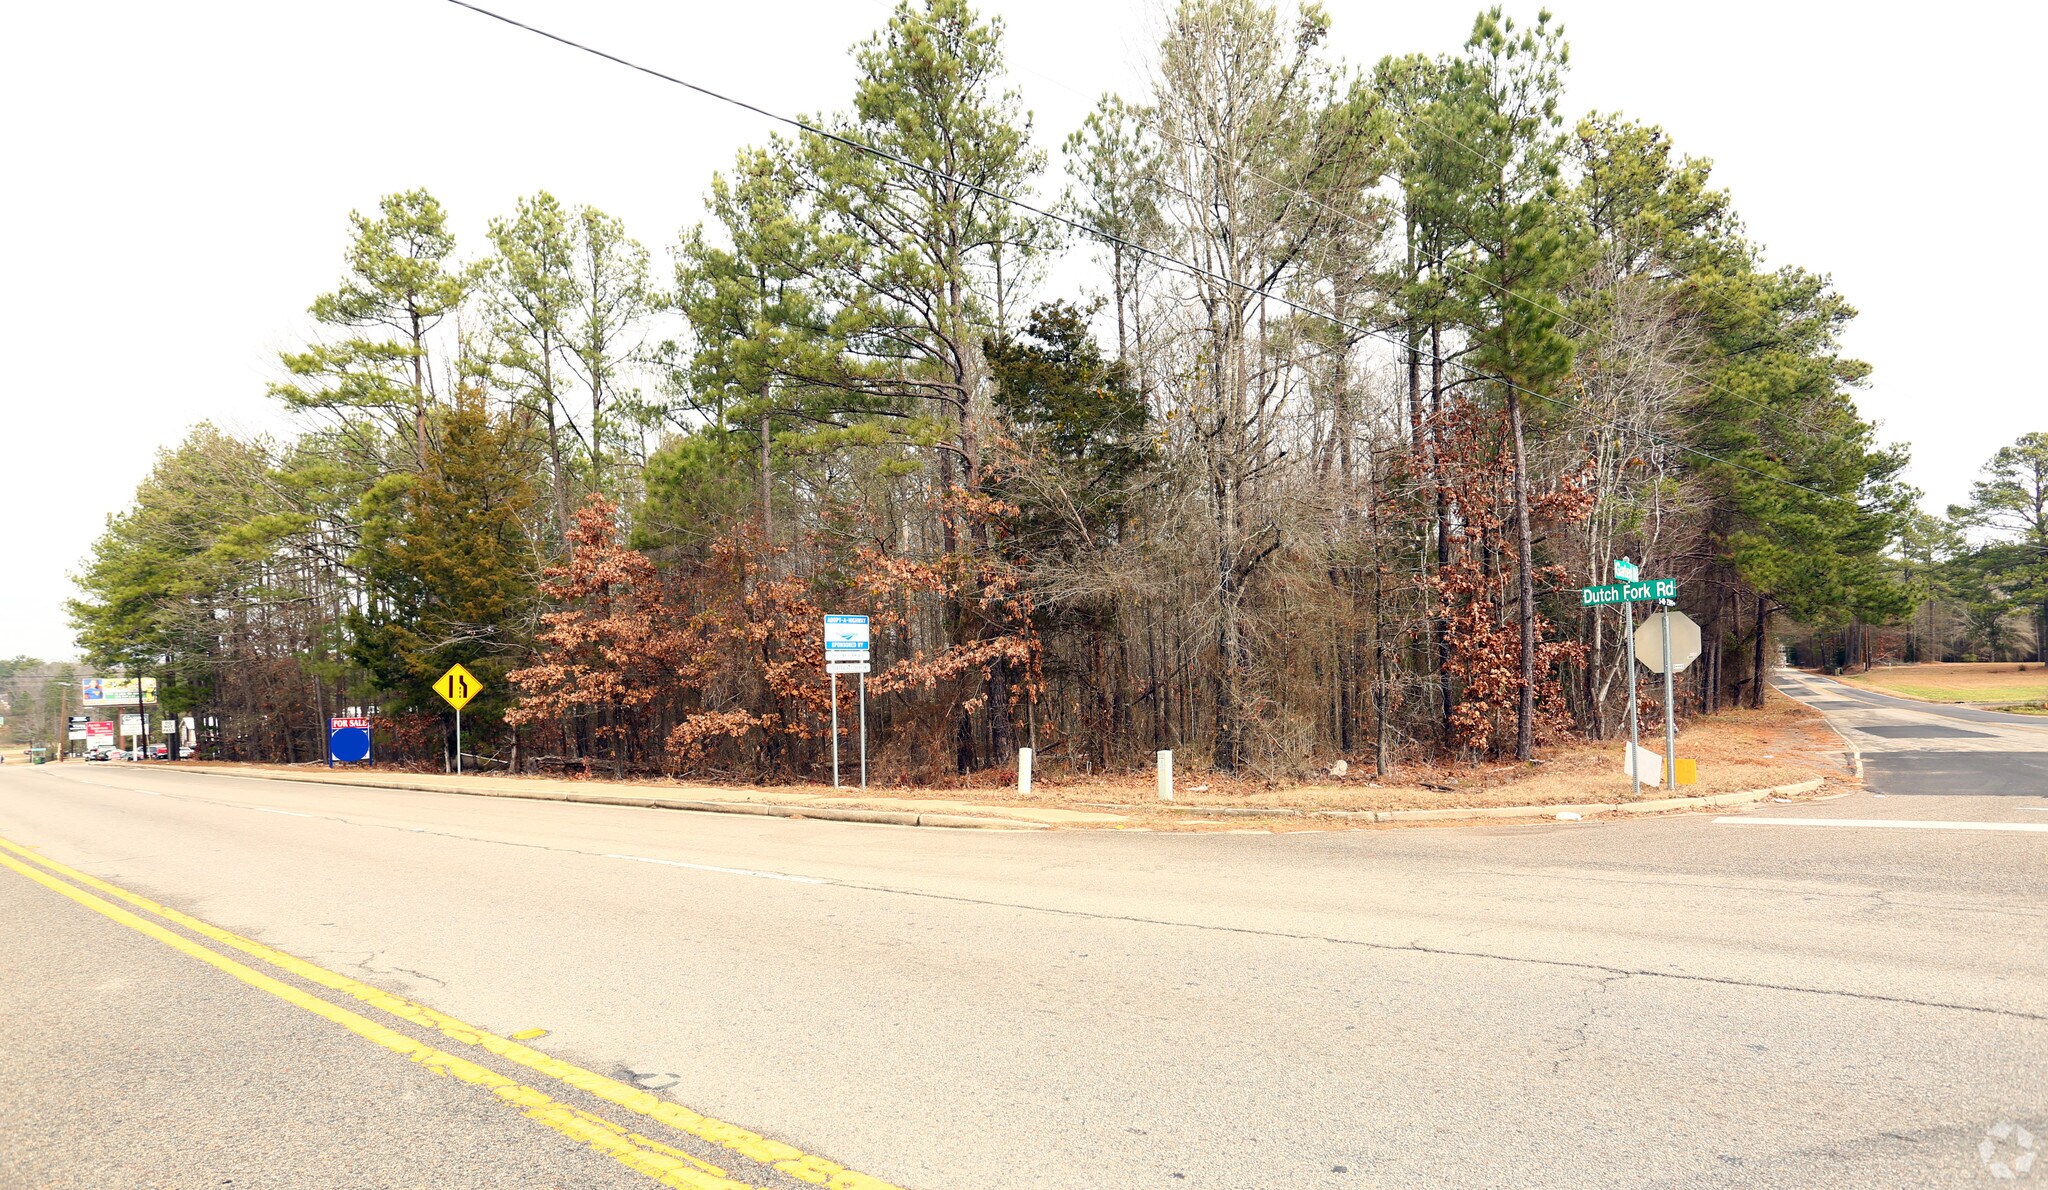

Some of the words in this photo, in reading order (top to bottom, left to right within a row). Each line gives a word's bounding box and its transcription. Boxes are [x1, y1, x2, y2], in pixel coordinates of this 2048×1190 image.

[1584, 586, 1619, 604] Dutch
[1623, 583, 1652, 600] Fork
[1656, 581, 1674, 597] Rd
